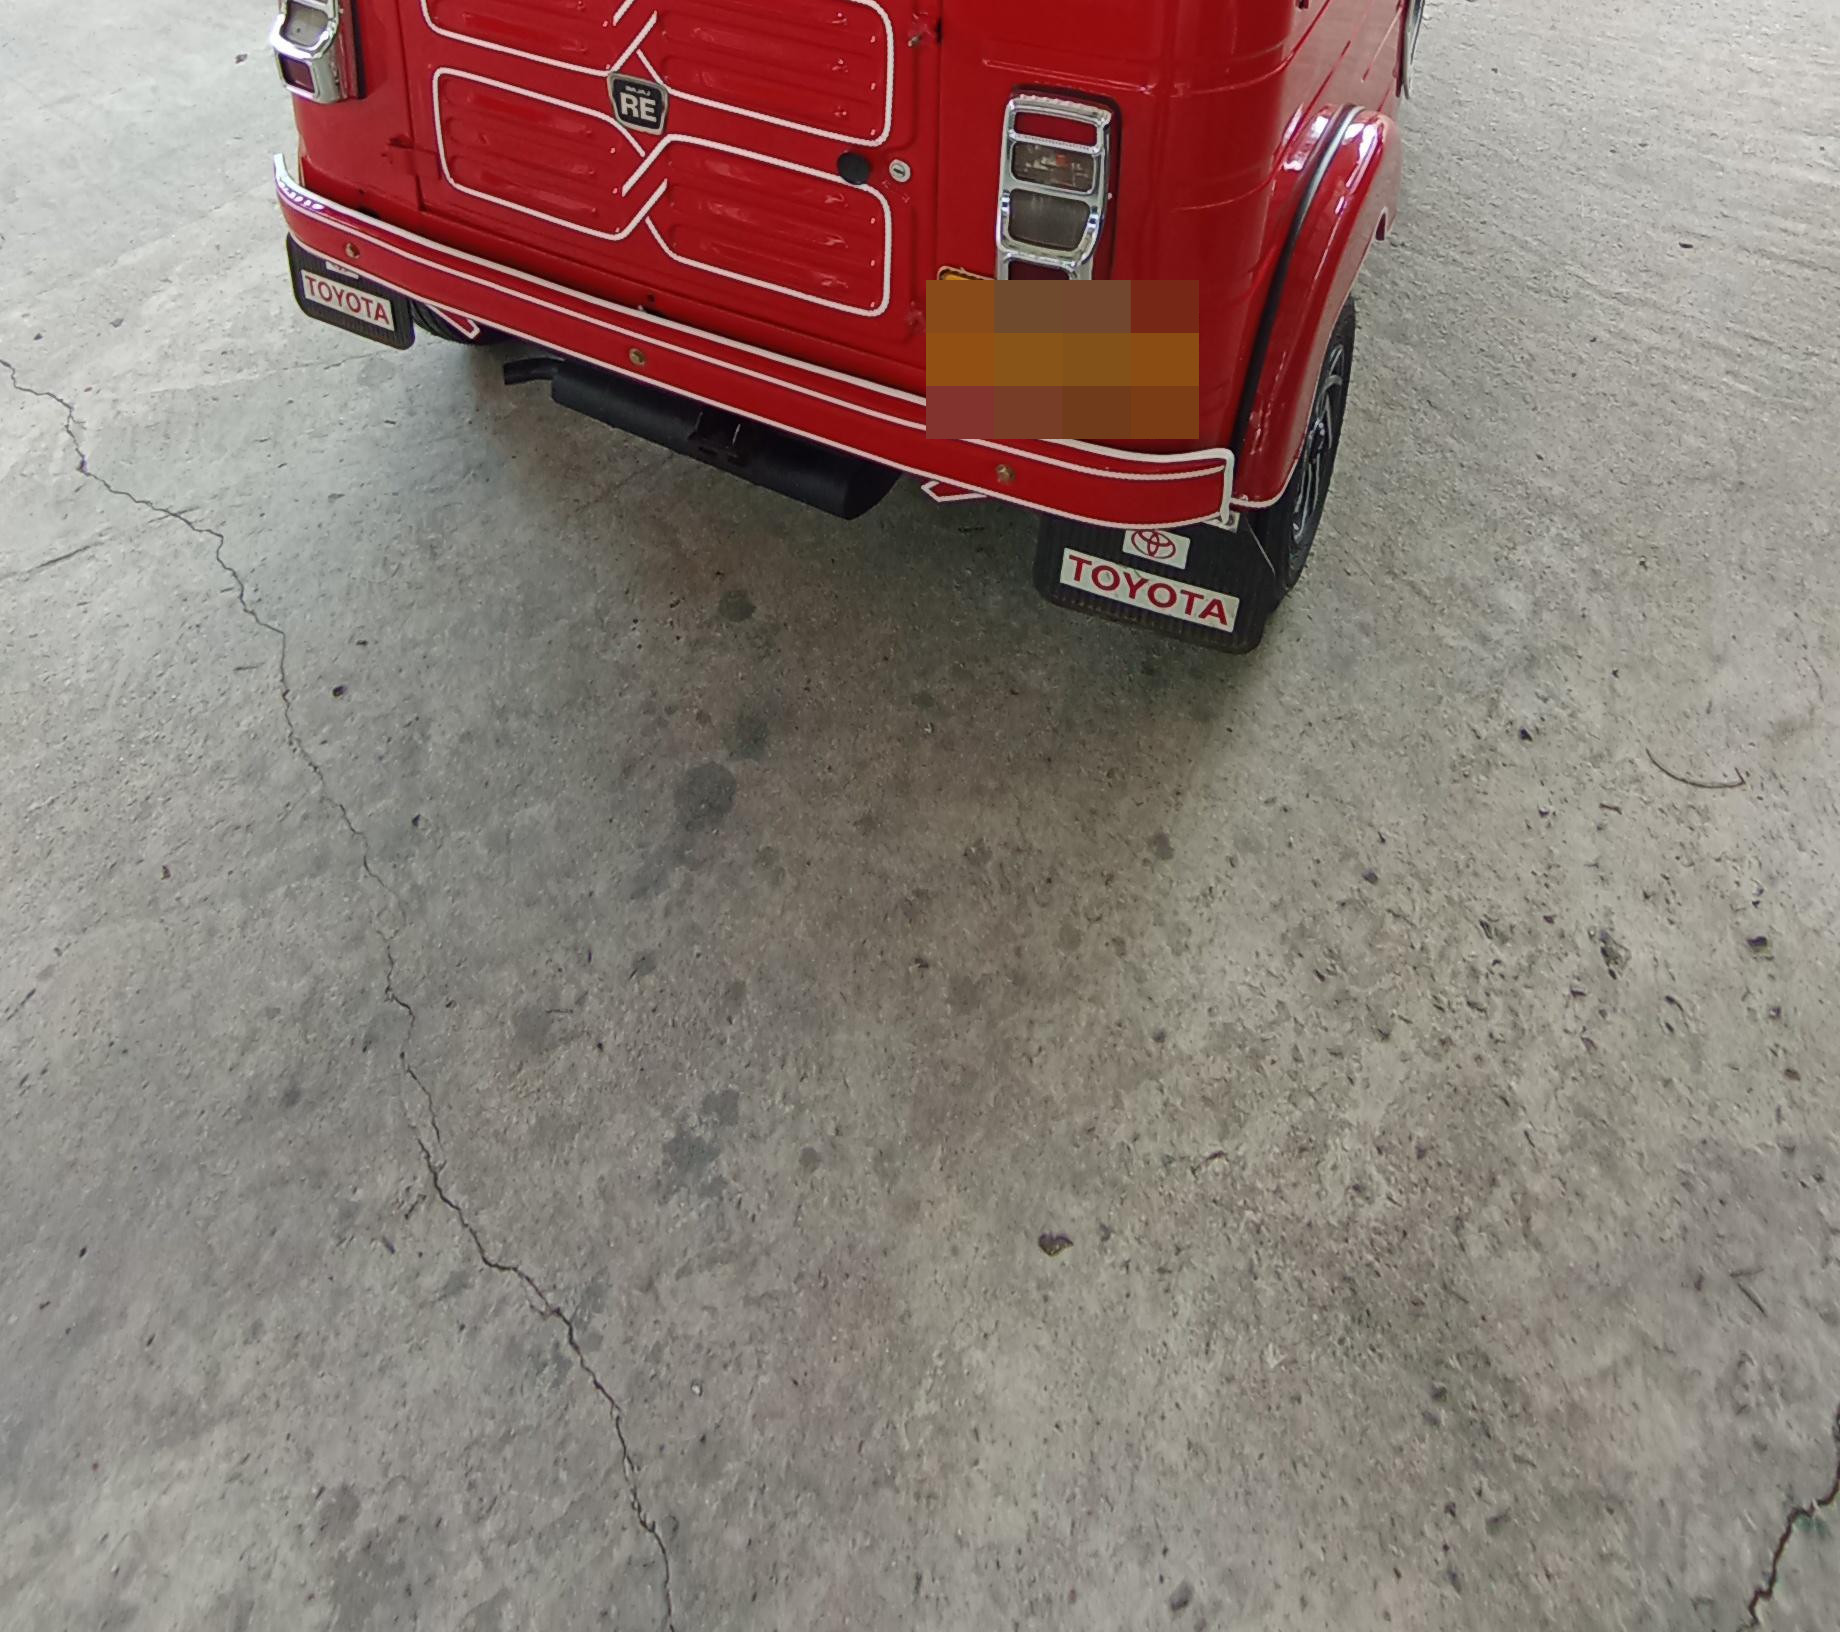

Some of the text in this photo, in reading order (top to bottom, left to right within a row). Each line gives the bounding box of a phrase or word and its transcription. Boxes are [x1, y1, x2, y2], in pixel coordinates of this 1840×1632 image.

[619, 91, 657, 123] RE
[304, 274, 390, 325] TOYOTA
[1068, 554, 1229, 626] TOYOTA
